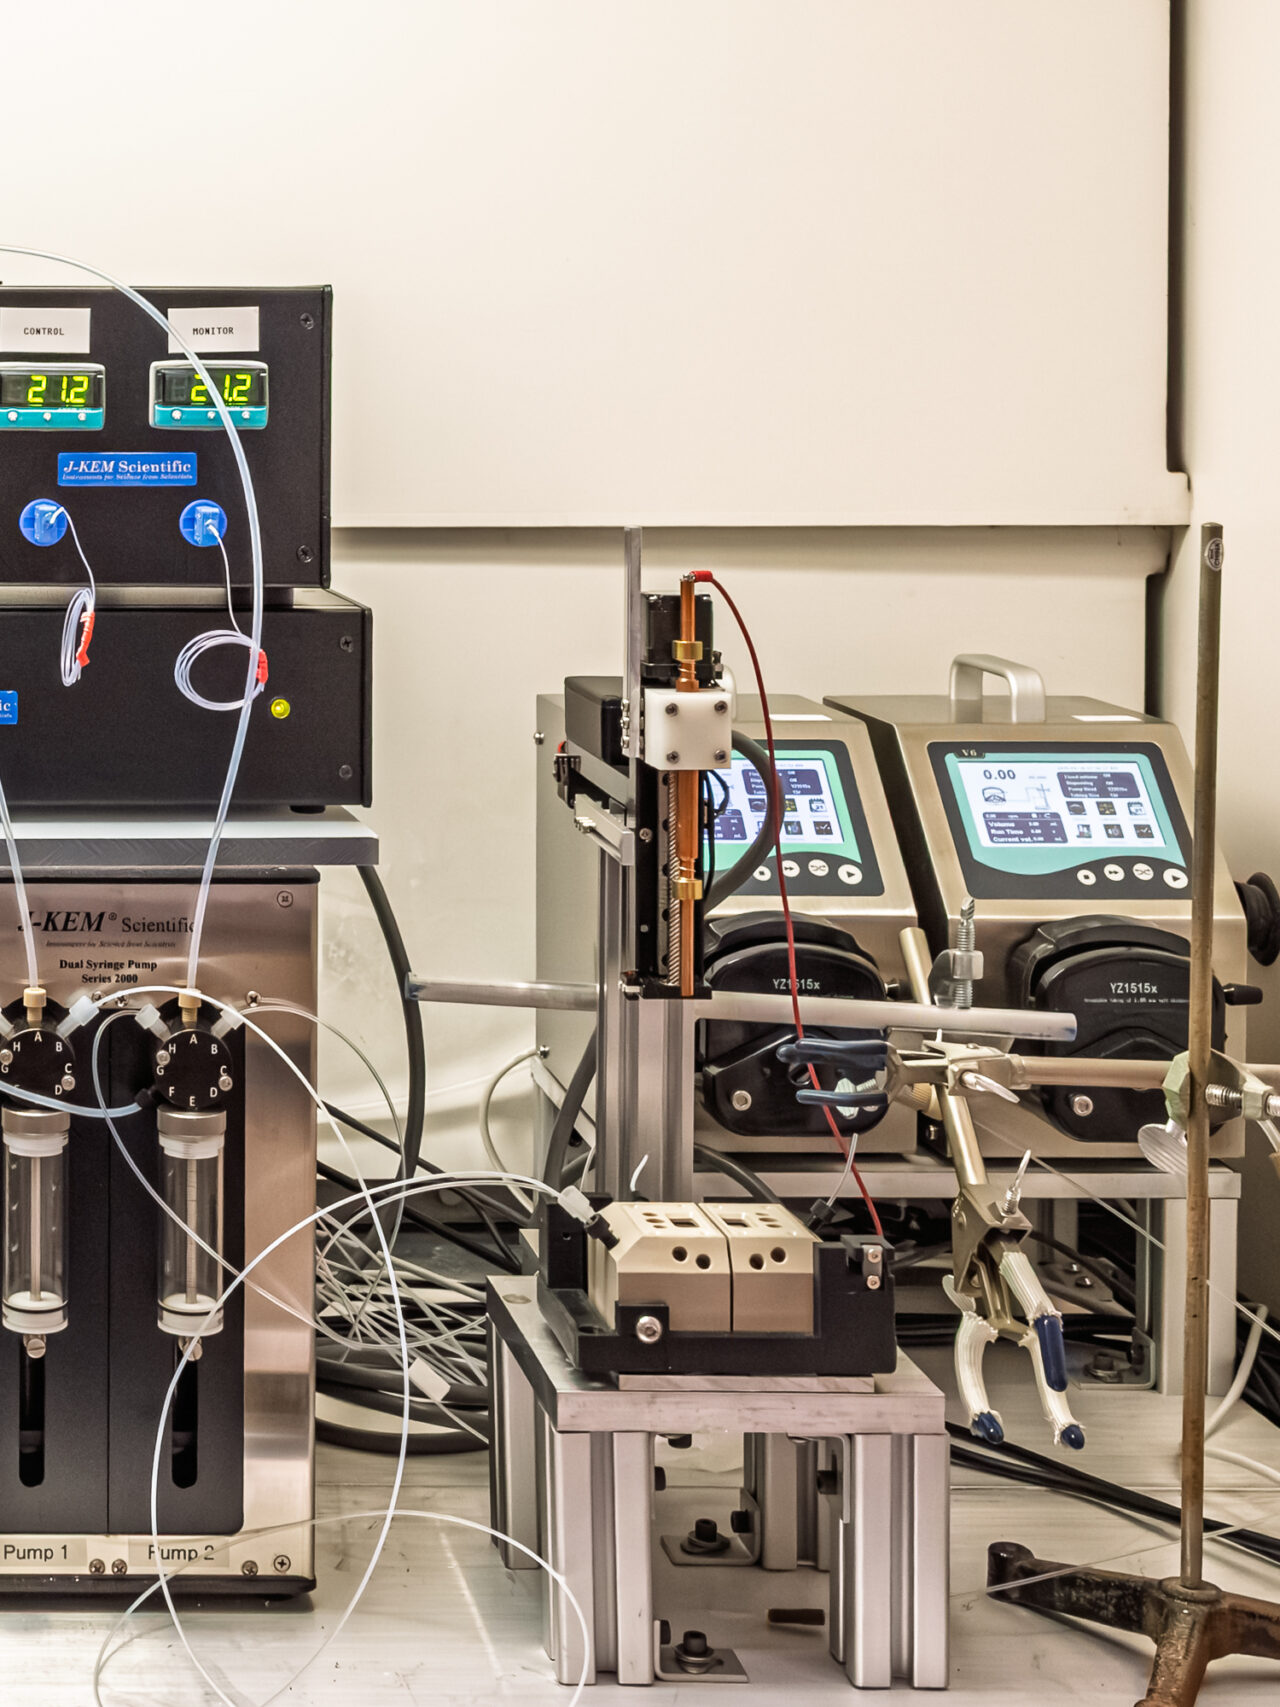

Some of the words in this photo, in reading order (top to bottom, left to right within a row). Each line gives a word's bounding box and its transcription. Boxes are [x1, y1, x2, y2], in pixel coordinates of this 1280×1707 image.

[23, 327, 65, 336] CONTROL
[192, 326, 234, 336] MONITOR
[27, 375, 89, 404] 21.2
[63, 460, 116, 473] J-KEM
[118, 460, 192, 473] Scientific
[983, 769, 1016, 780] 0.00
[59, 960, 84, 969] Dual
[86, 960, 125, 971] Syringe
[128, 960, 158, 971] Pump
[81, 974, 112, 984] Series
[115, 974, 138, 984] 2000
[1110, 982, 1158, 994] YZ1515x
[34, 1031, 43, 1042] A
[189, 1033, 198, 1044] A
[13, 1041, 21, 1052] H
[55, 1041, 63, 1052] B
[168, 1043, 177, 1054] H
[211, 1043, 218, 1055] B
[0, 1063, 9, 1074] G
[64, 1063, 73, 1074] C
[156, 1065, 165, 1076] G
[220, 1065, 228, 1076] C
[54, 1084, 63, 1096] D
[168, 1086, 175, 1097] F
[209, 1087, 218, 1098] D
[189, 1096, 196, 1107] E
[3, 1544, 54, 1562] Pump
[61, 1544, 68, 1559] 1
[204, 1544, 215, 1560] 2
